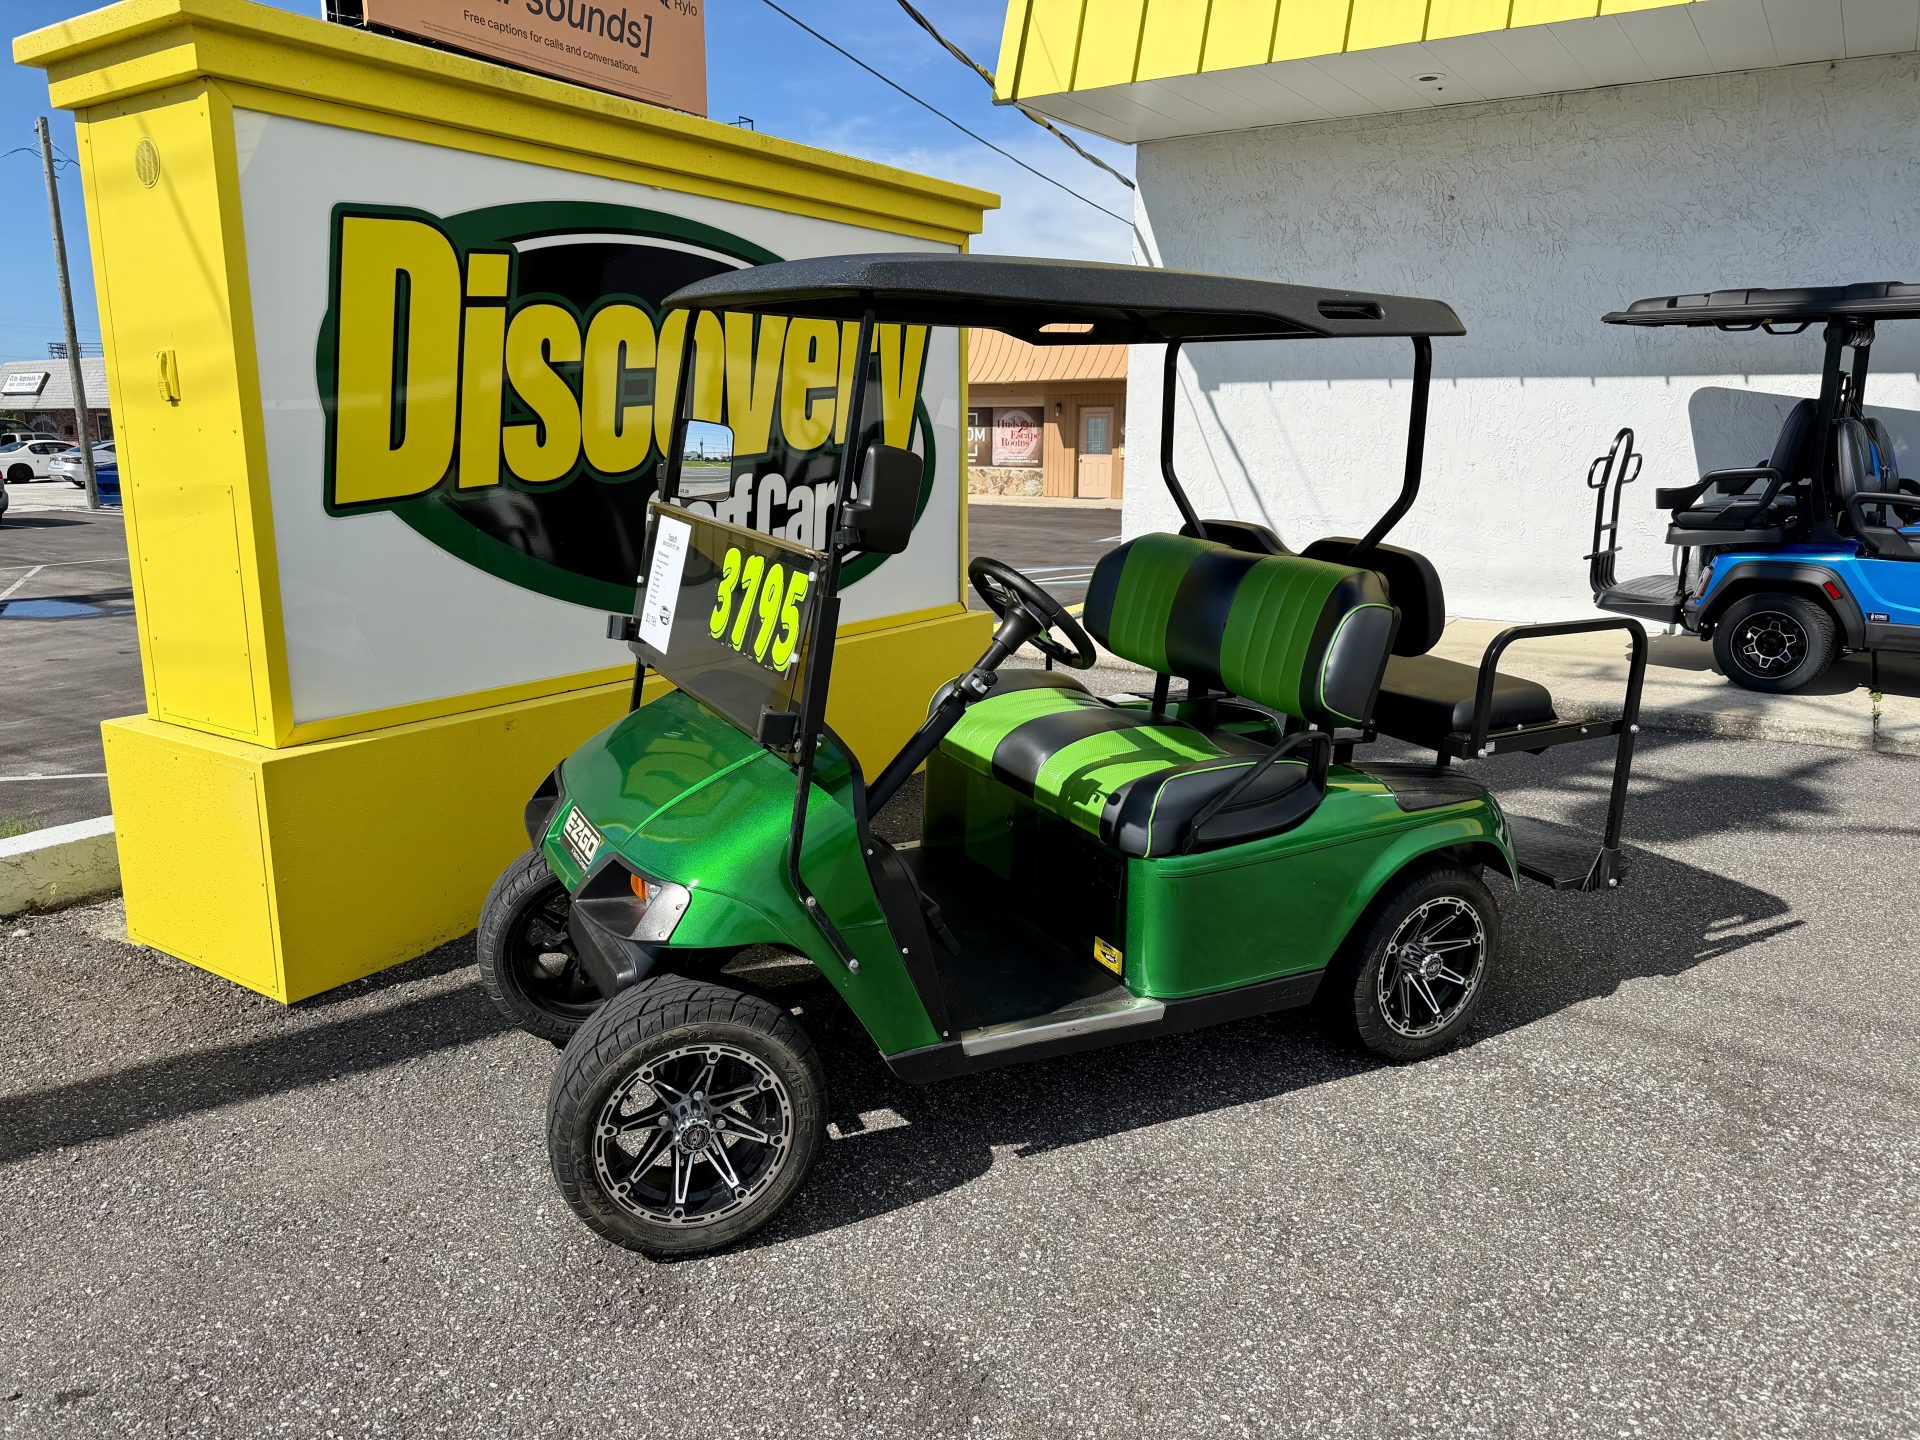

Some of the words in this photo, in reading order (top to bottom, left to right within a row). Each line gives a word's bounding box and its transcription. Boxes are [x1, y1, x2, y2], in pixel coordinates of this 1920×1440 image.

[463, 9, 486, 26] Free
[487, 19, 528, 40] captions
[529, 30, 542, 43] for
[544, 36, 564, 51] calls
[565, 43, 582, 57] and
[582, 49, 641, 75] conversations.
[334, 216, 928, 505] Discovery
[997, 419, 1035, 429] Hudson
[1001, 438, 1030, 447] Rooms
[1011, 430, 1040, 441] Escape
[710, 547, 809, 672] 3795
